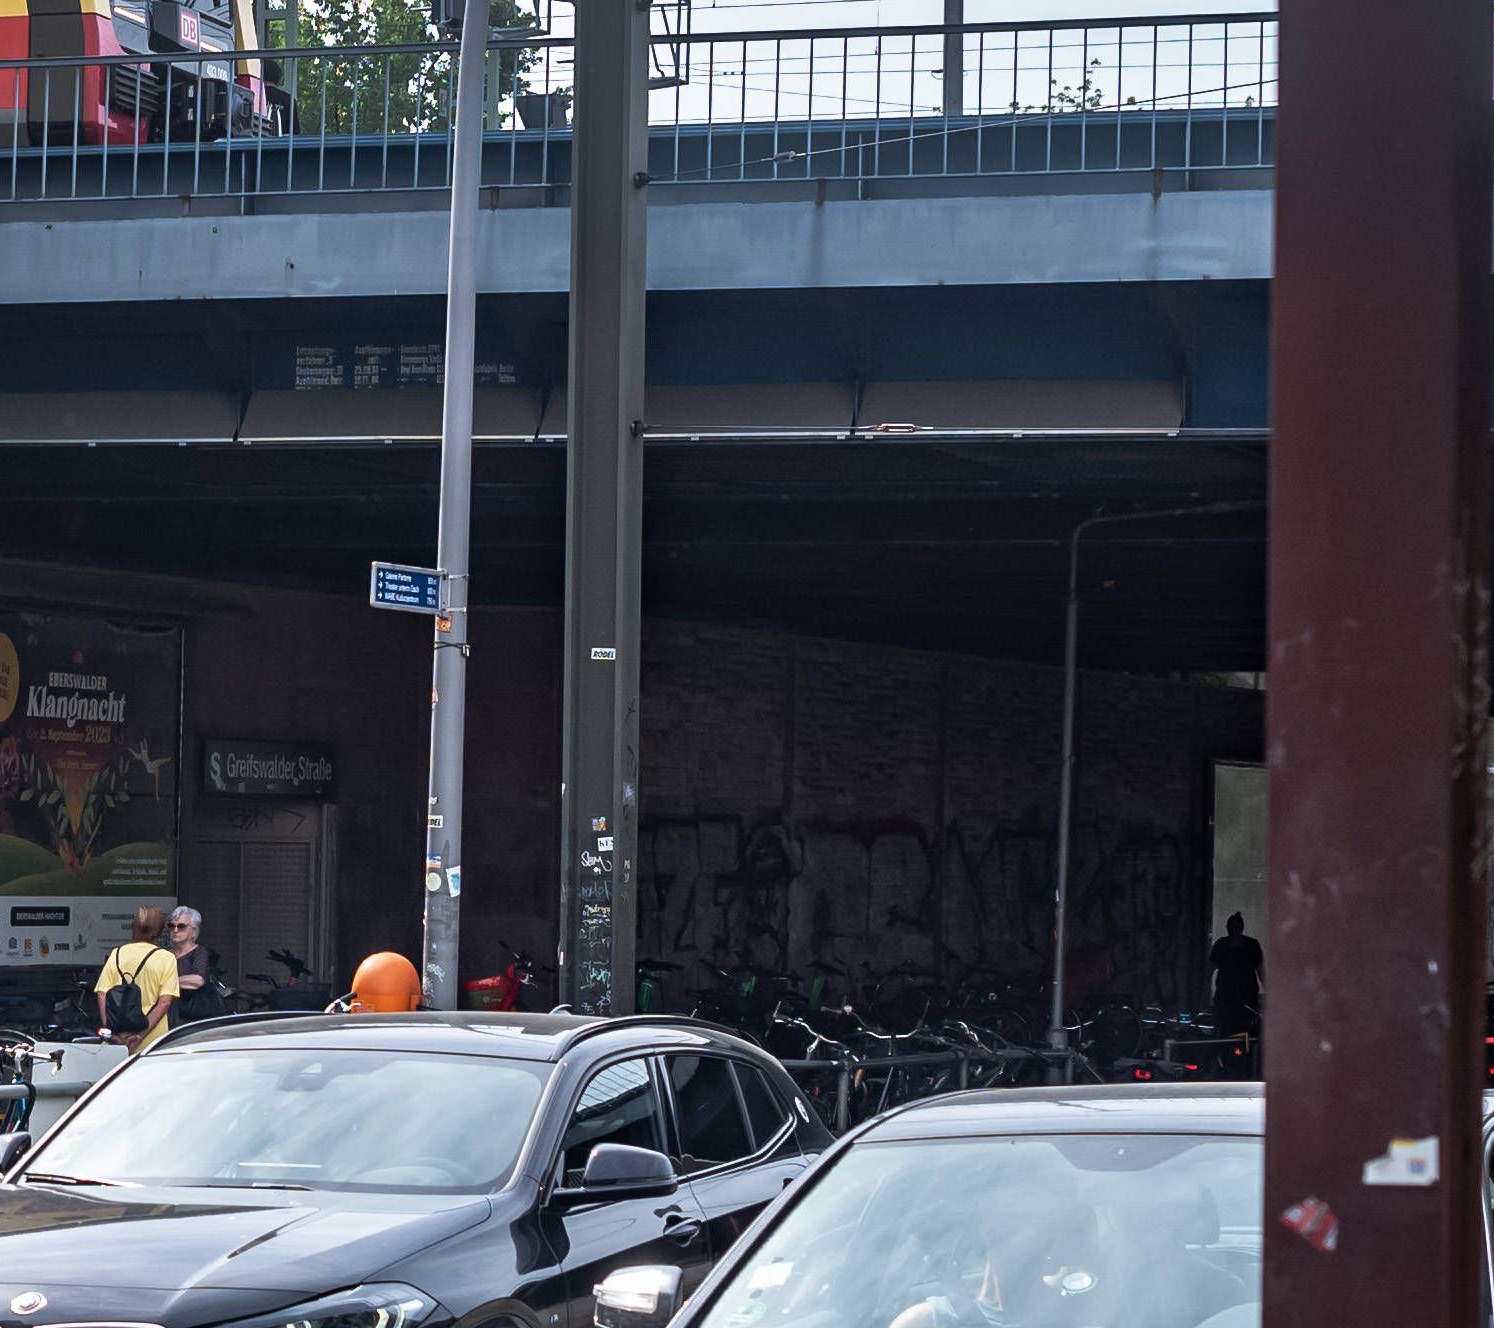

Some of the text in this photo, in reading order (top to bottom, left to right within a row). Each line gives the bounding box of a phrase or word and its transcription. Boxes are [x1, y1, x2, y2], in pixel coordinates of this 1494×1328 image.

[183, 16, 196, 44] DB
[49, 672, 107, 691] EBERSWALDER
[26, 685, 127, 728] Klangnacht
[227, 753, 296, 780] Greifswalder
[298, 756, 332, 781] Straße
